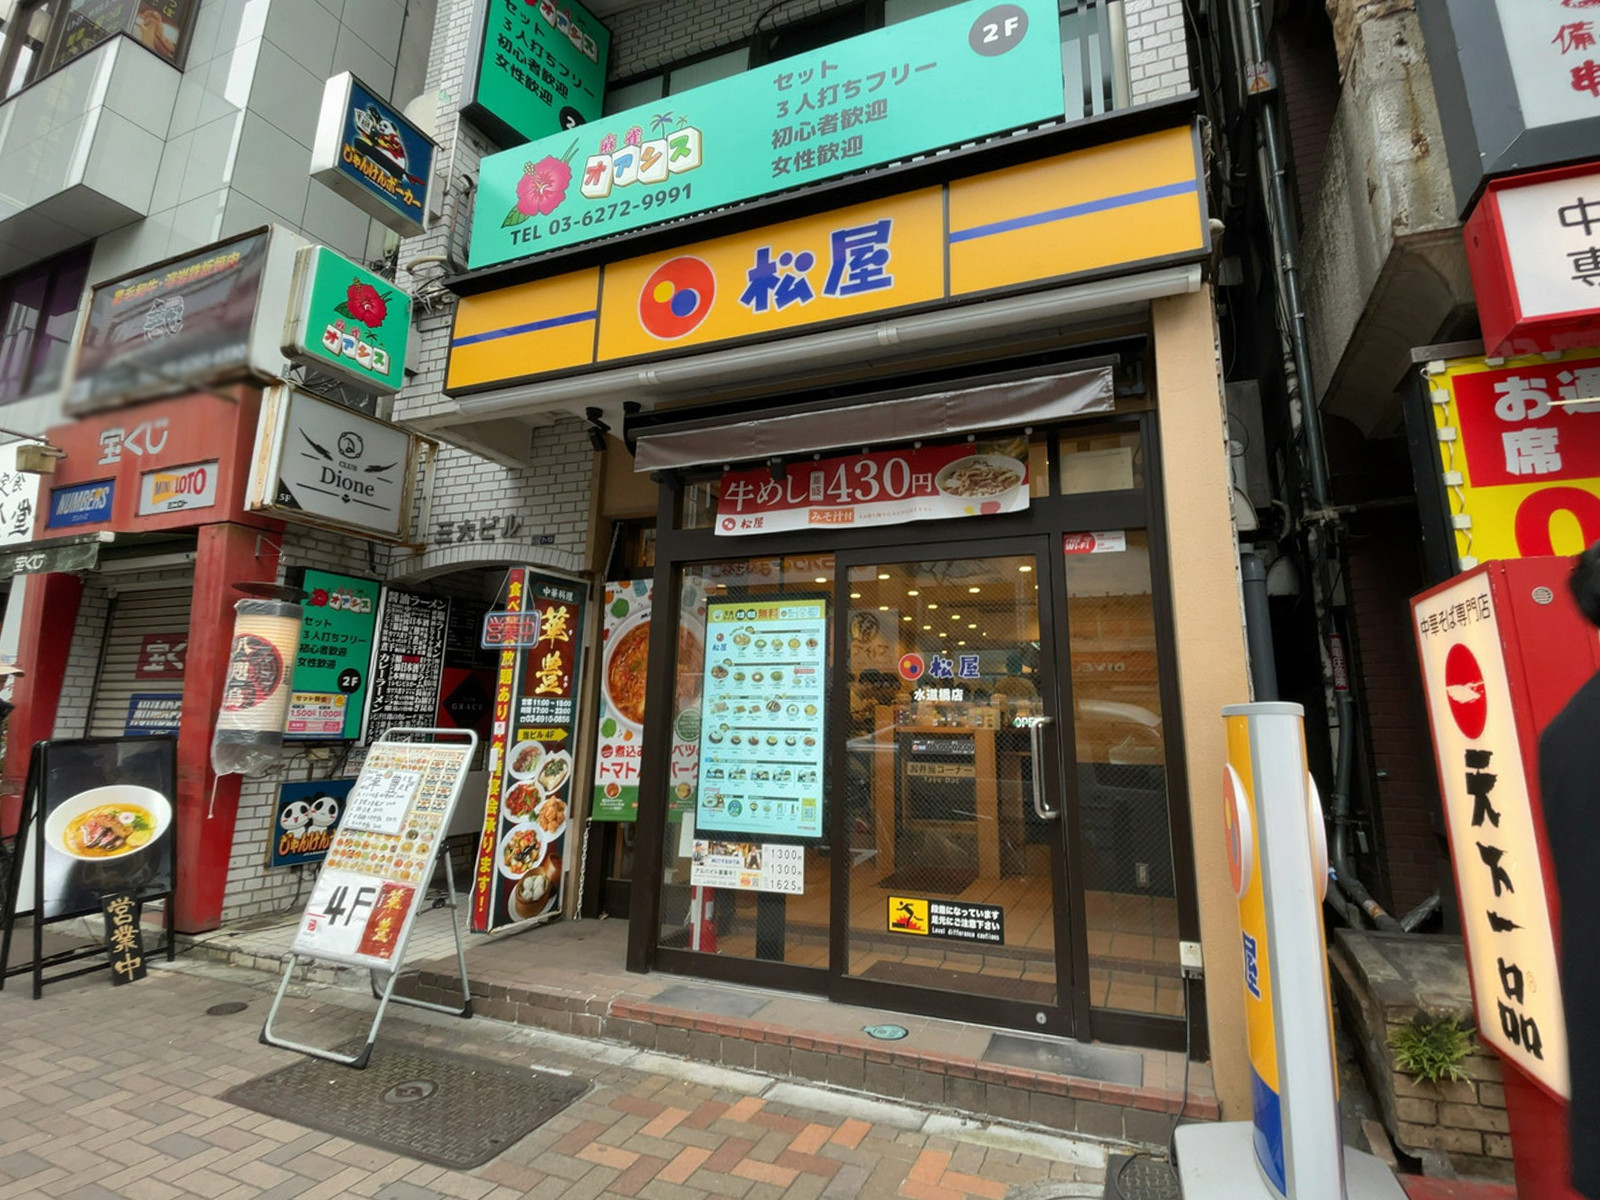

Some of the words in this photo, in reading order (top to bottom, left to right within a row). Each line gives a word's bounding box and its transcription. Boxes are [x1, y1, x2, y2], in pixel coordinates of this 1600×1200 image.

[504, 0, 546, 37] セット
[542, 1, 595, 54] オアシス
[982, 16, 1019, 43] 2F
[495, 53, 553, 106] 女性歓迎
[497, 34, 568, 99] 初心者歓迎
[773, 59, 838, 91] セット
[776, 62, 937, 118] 3人打ちフリー
[771, 98, 888, 149] 初心者歓迎
[585, 135, 692, 186] オアシス
[771, 135, 864, 178] 女性歓迎
[510, 228, 542, 246] TEL
[549, 183, 692, 237] 03-6272-9991
[1558, 197, 1600, 236] 中
[738, 218, 894, 314] 松屋
[324, 329, 385, 367] オアシス
[98, 419, 170, 465] 宝くじ
[1501, 427, 1563, 476] 席
[175, 468, 206, 494] LOTO
[320, 466, 375, 497] Dione
[724, 474, 808, 512] 牛めし
[828, 457, 933, 503] 430円
[56, 487, 110, 515] NUMBERS
[434, 514, 522, 545] 三大ビル
[741, 517, 764, 529] 松屋
[304, 616, 332, 628] セット
[1420, 592, 1491, 640] 中華そば専門店
[297, 657, 336, 670] 女性歓迎
[300, 643, 348, 658] 初心者歓迎
[929, 655, 980, 678] 松屋
[342, 676, 358, 687] 2F
[914, 688, 964, 702] 水道橋店
[1014, 716, 1037, 728] OPE
[599, 762, 641, 779] トマト
[278, 829, 337, 856] じゃんけん
[323, 885, 377, 927] 4F
[931, 903, 1000, 920] 段差になっています
[931, 914, 1001, 931] 足元にご注意下さい
[106, 896, 142, 981] 営業中
